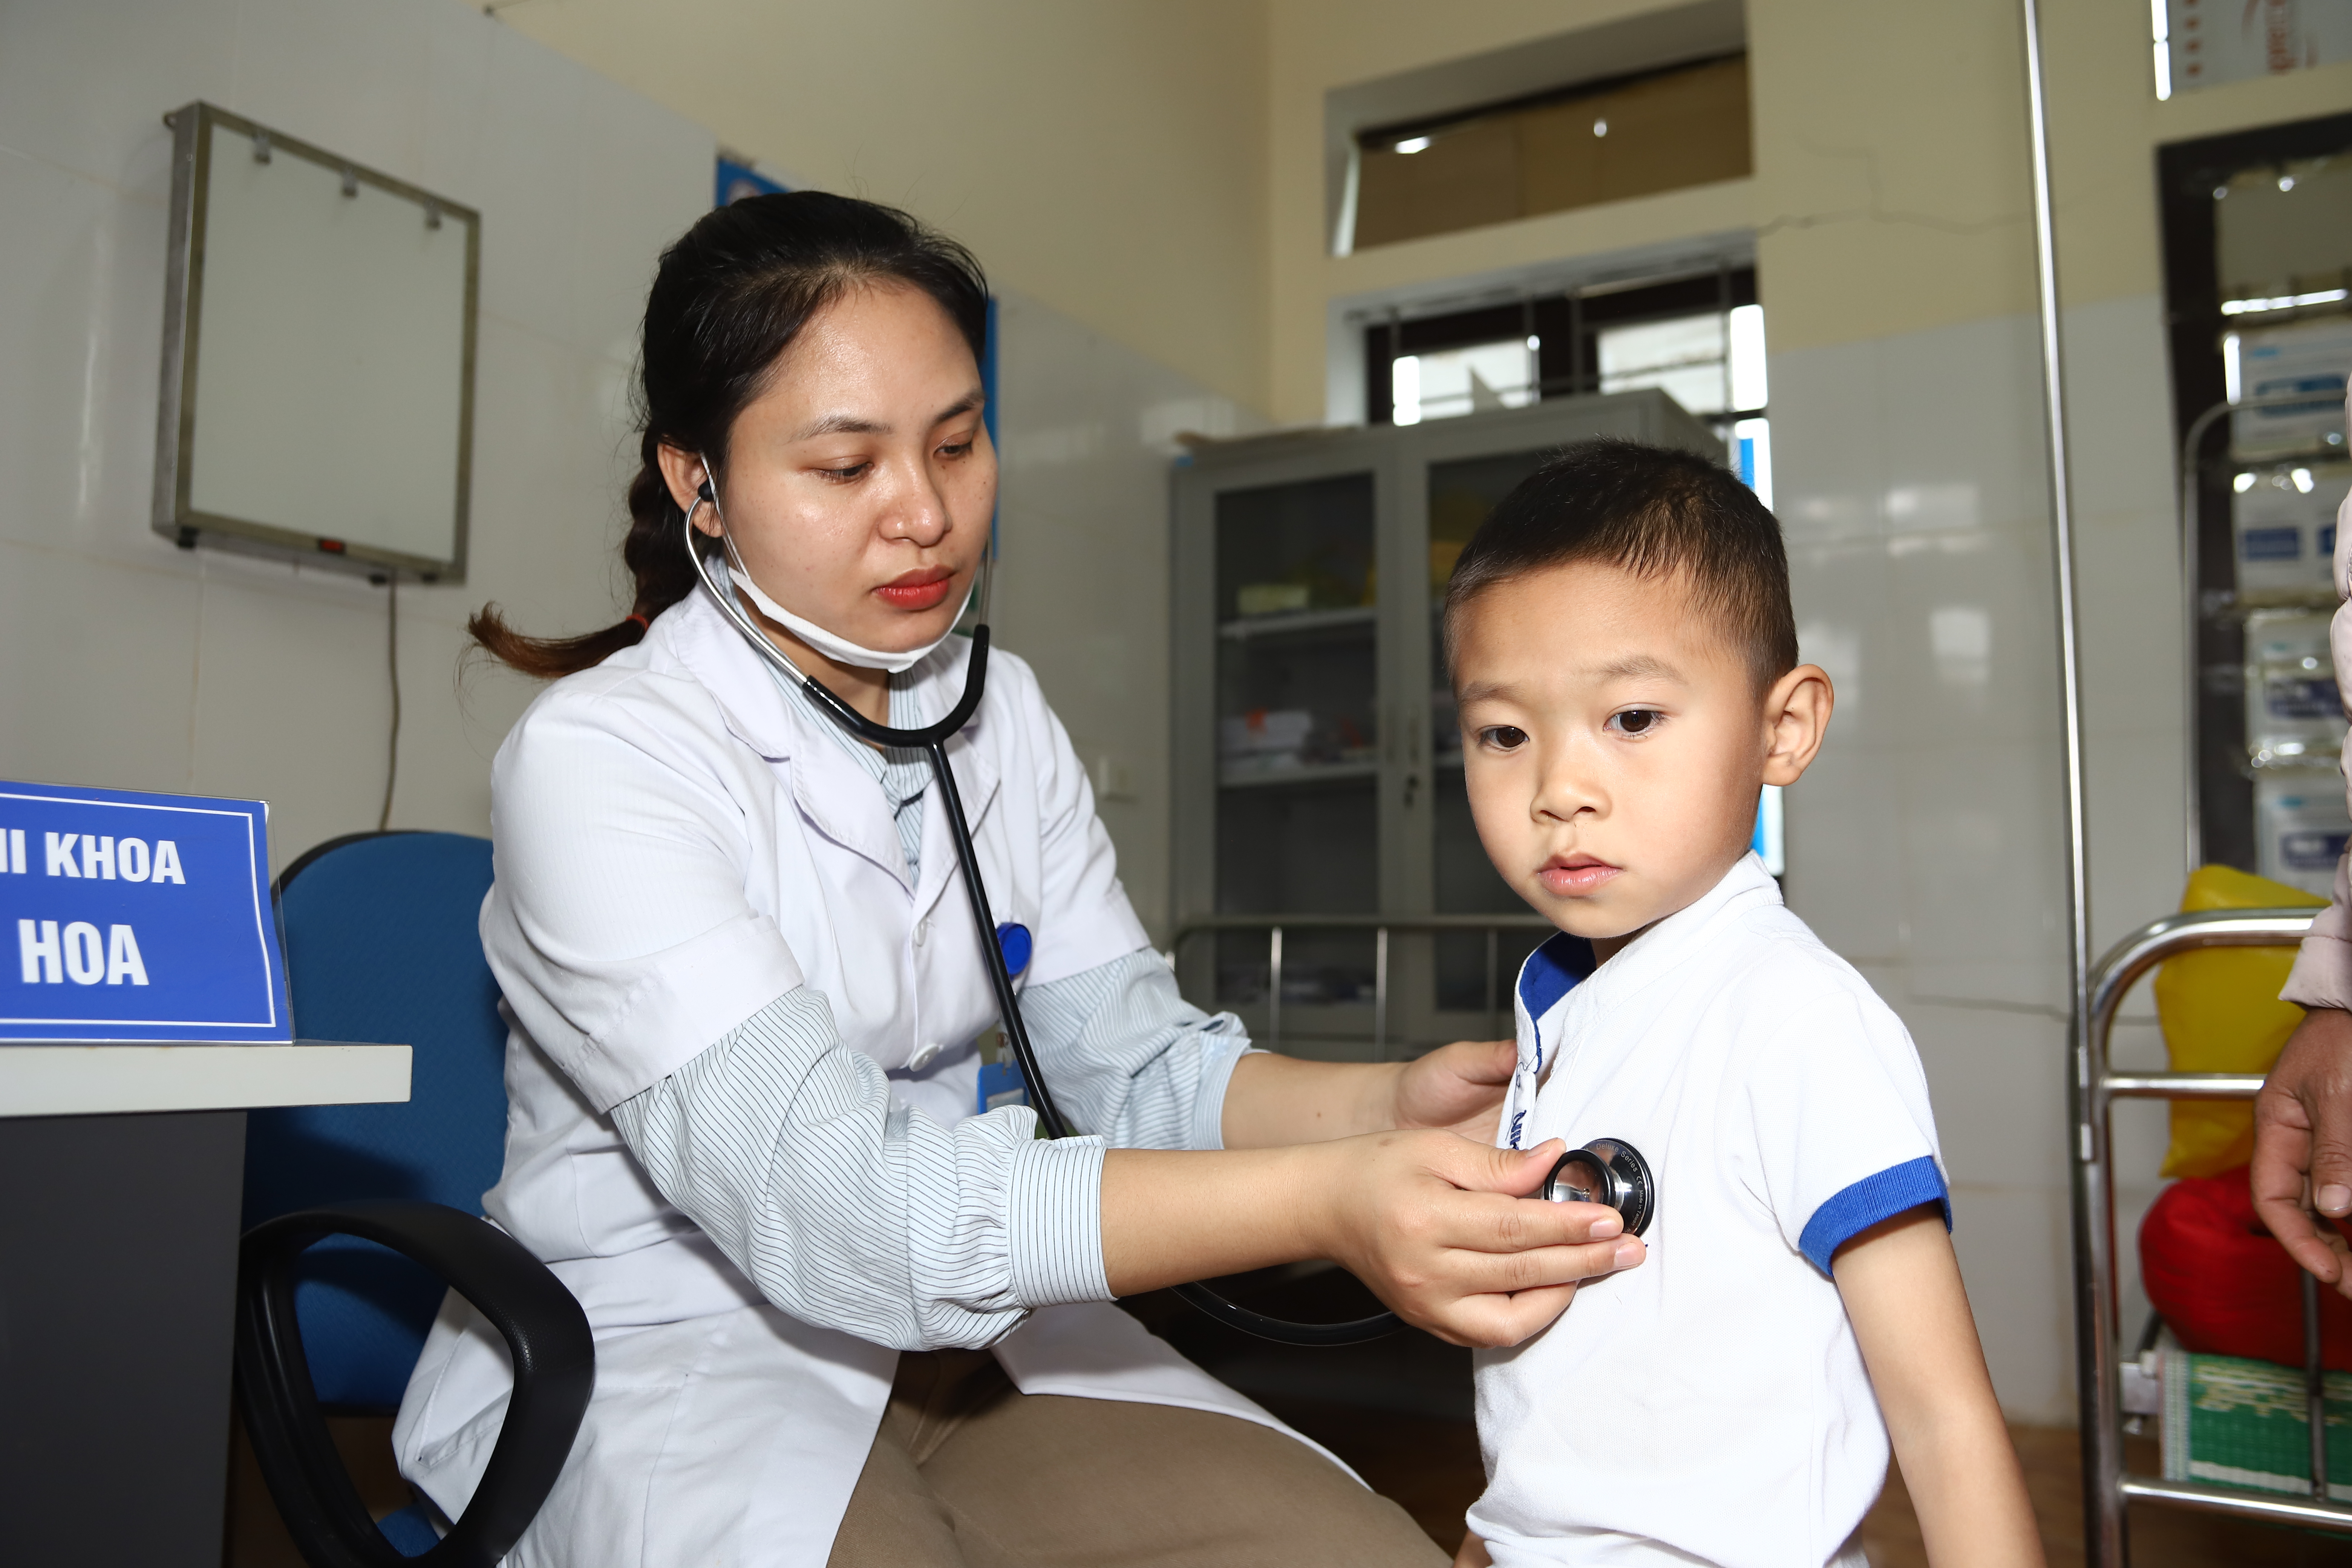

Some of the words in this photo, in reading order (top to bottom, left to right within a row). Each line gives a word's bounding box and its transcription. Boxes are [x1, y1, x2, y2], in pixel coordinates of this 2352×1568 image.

[46, 831, 186, 885] KHOA
[18, 919, 150, 985] HOA
[1596, 1143, 1619, 1152] Deluxe
[1621, 1151, 1638, 1172] Series
[1632, 1210, 1641, 1226] Taiwan
